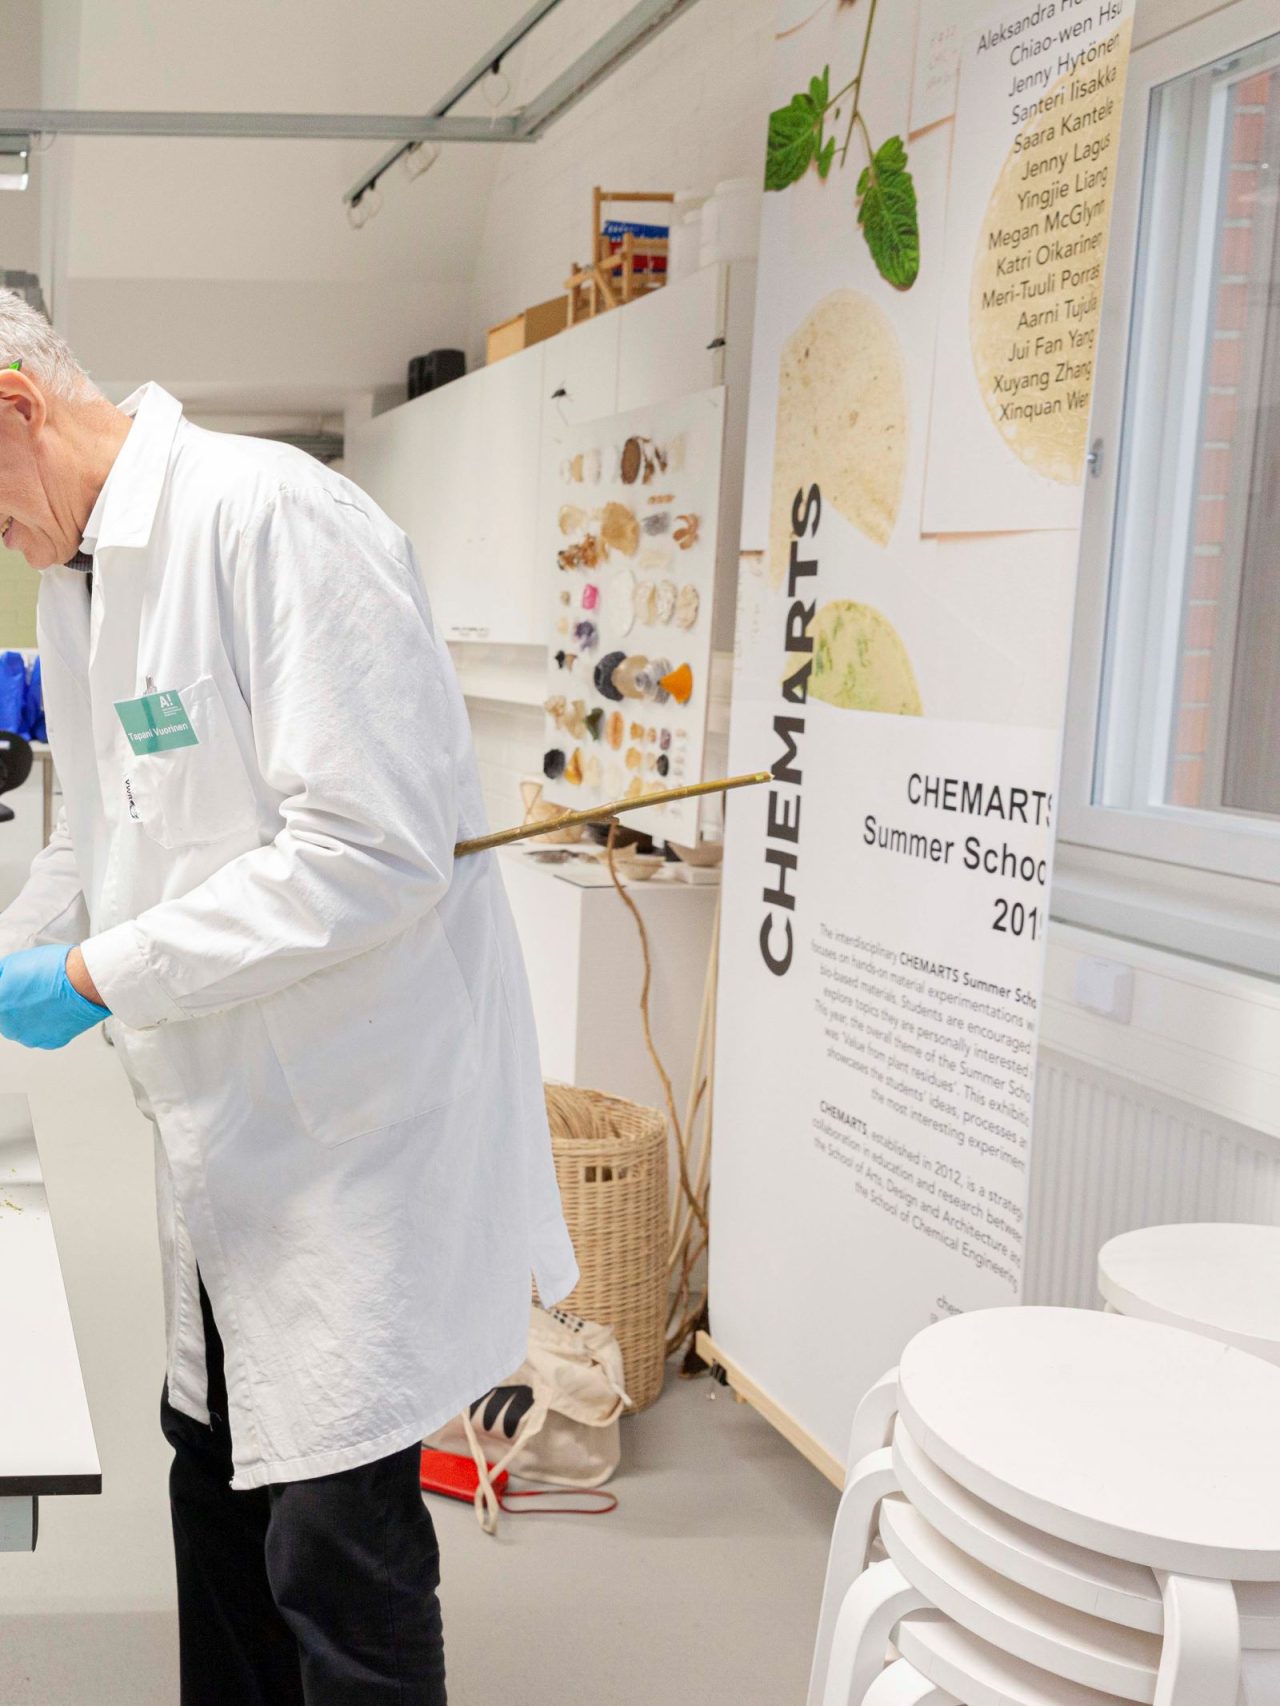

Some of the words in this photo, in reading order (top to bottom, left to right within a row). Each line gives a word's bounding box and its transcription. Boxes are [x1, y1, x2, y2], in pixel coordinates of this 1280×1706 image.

[977, 3, 1055, 54] Aleksandra
[1010, 17, 1092, 66] Chiao-wen
[1008, 66, 1052, 97] Jenny
[1012, 86, 1065, 125] Santeri
[1013, 126, 1055, 154] Saara
[1022, 152, 1068, 181] Jenny
[1073, 133, 1111, 162] Lagus
[1018, 180, 1069, 211] Yingjie
[1075, 166, 1108, 193] Liang
[989, 223, 1039, 250] Megan
[996, 249, 1032, 277] Katri
[982, 273, 1056, 310] Meri-Tuuli
[1017, 302, 1059, 330] Aarni
[1008, 340, 1031, 362] Jui
[1035, 336, 1063, 356] Fan
[993, 371, 1050, 397] Xuyang
[999, 399, 1062, 422] Xinquan
[760, 482, 822, 977] CHEMARTS
[864, 815, 955, 864] Summer
[992, 898, 1044, 941] 201
[899, 951, 959, 983] CHEMARTS
[963, 972, 1012, 999] Summer
[927, 987, 1024, 1028] experimentations
[917, 1027, 971, 1058] personally
[974, 1042, 1029, 1077] interested
[946, 1014, 965, 1030] are
[967, 1022, 1032, 1055] encouraged
[939, 1054, 957, 1072] the
[960, 1061, 1006, 1090] Summer
[964, 1084, 986, 1106] This
[963, 1111, 1017, 1143] processes
[934, 1161, 964, 1188] 2012,
[967, 1175, 976, 1192] is
[978, 1186, 986, 1197] a
[938, 1188, 984, 1219] research
[911, 1214, 959, 1252] Chemical
[942, 1209, 1008, 1256] Architecture
